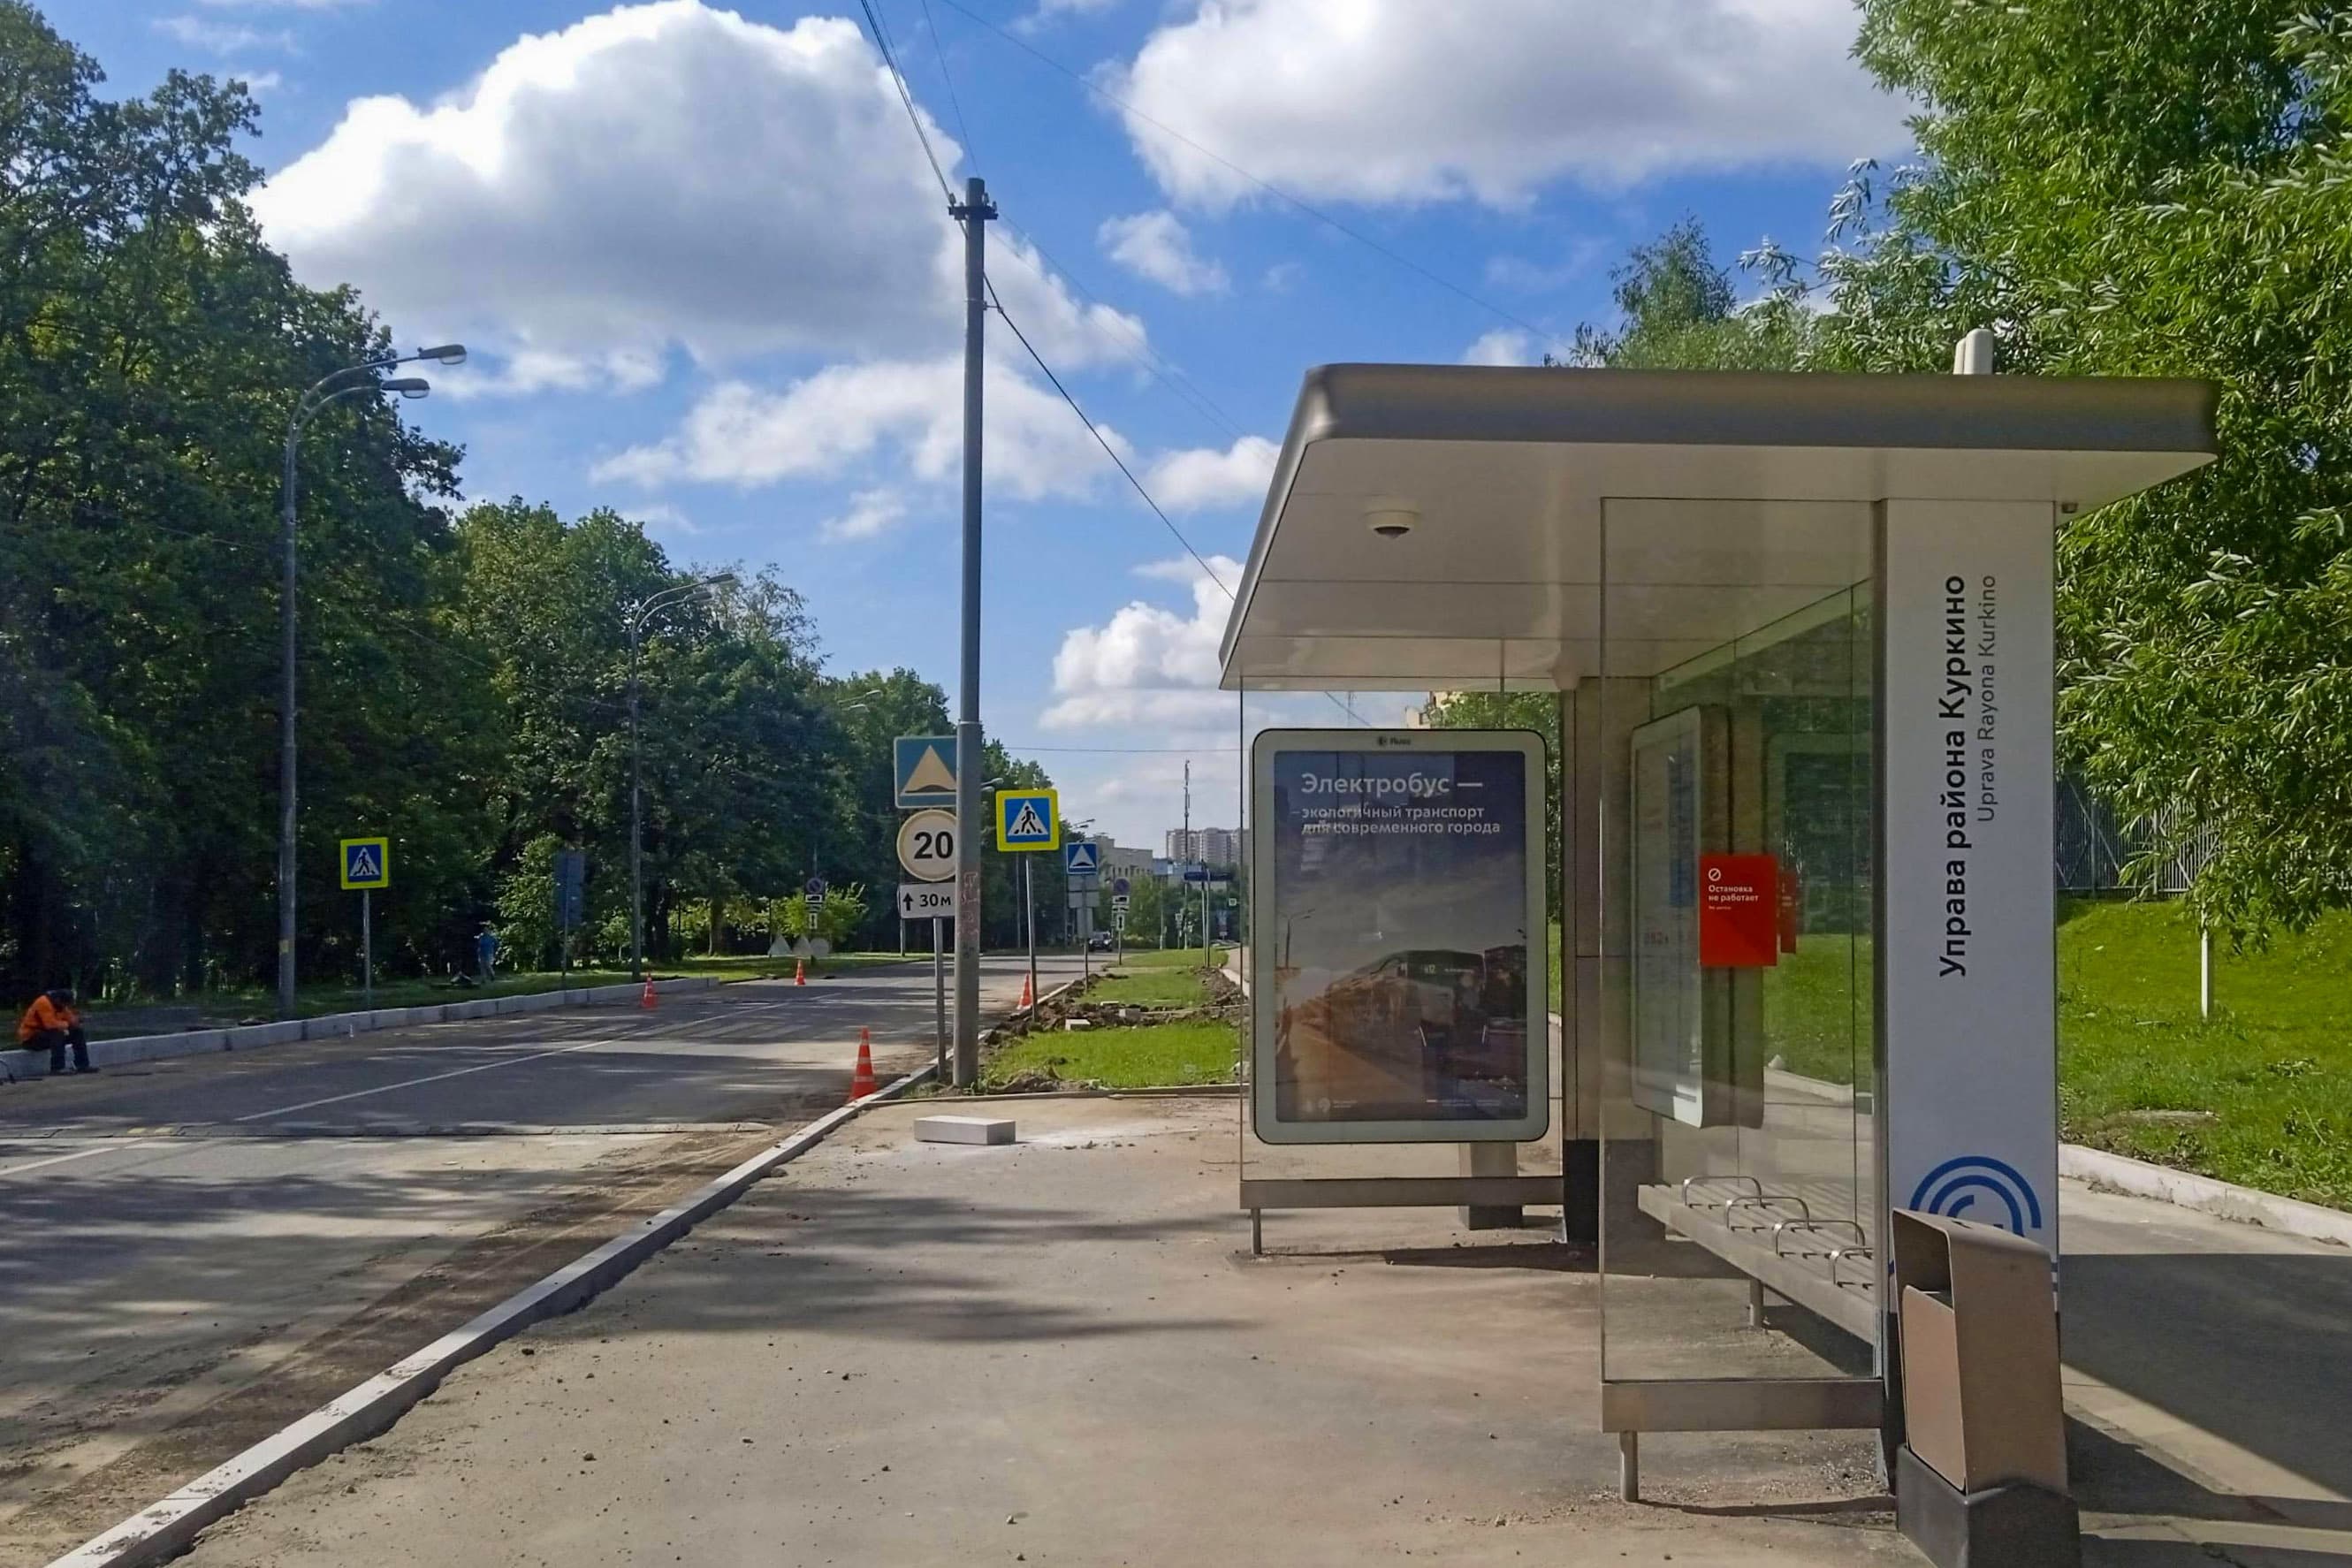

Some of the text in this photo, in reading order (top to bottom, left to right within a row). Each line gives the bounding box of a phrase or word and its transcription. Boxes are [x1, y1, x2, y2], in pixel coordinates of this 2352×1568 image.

[1977, 575, 2000, 823] Uprava Rayona Kurkino
[1301, 772, 1450, 798] Электробус
[1938, 575, 1973, 977] Управа района Куркино
[1301, 805, 1485, 819] экологичный транспорт
[1301, 823, 1501, 836] для современного города
[914, 832, 954, 859] 20
[1721, 893, 1759, 902] работает
